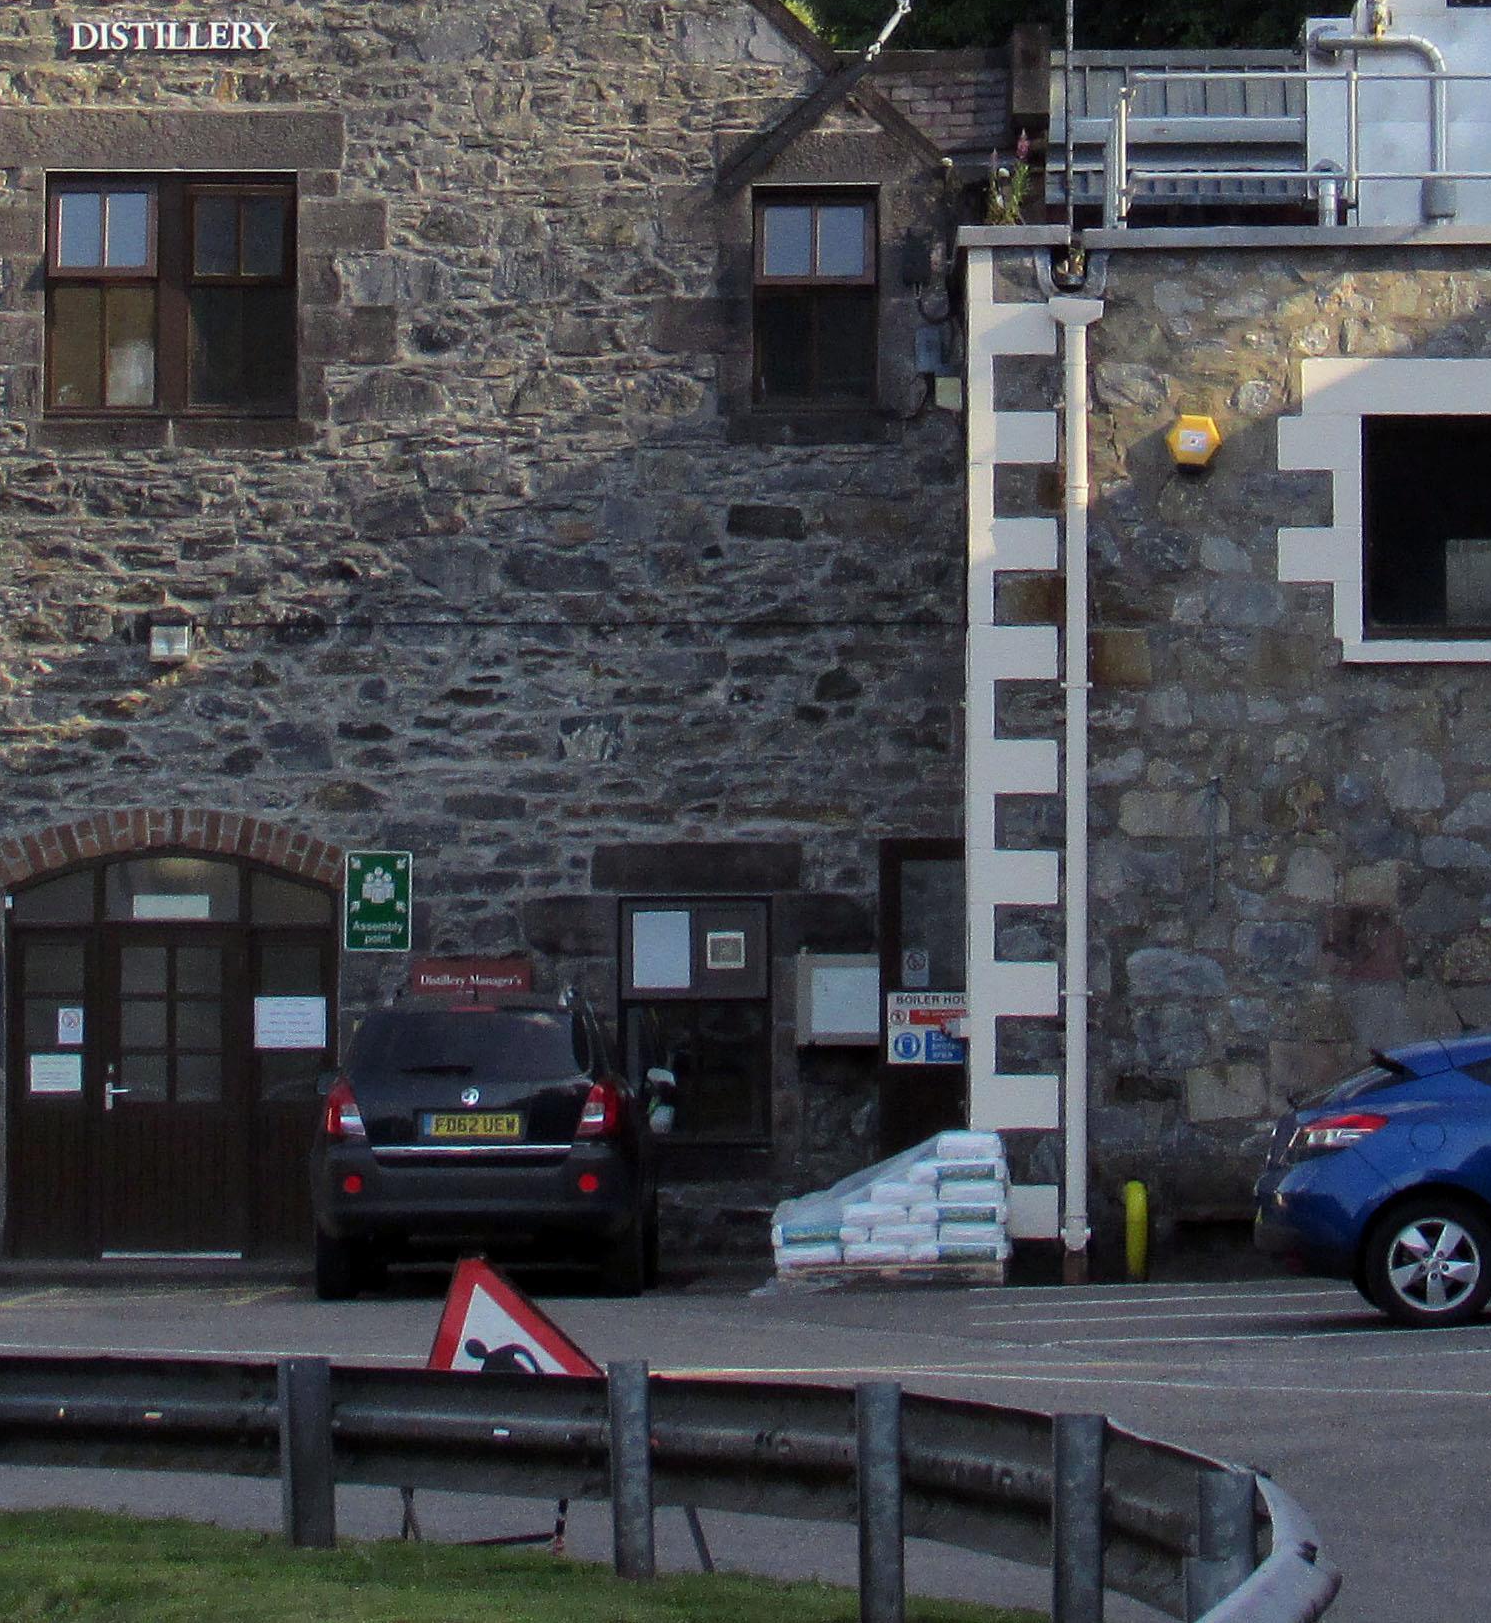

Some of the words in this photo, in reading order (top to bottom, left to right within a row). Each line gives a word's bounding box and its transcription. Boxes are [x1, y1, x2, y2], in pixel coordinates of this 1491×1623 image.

[71, 22, 278, 51] DISTILLERY
[352, 920, 404, 934] Assembly
[364, 933, 392, 945] point
[420, 974, 465, 986] Distillery
[470, 974, 522, 988] Manager's
[896, 995, 939, 1005] BOILER
